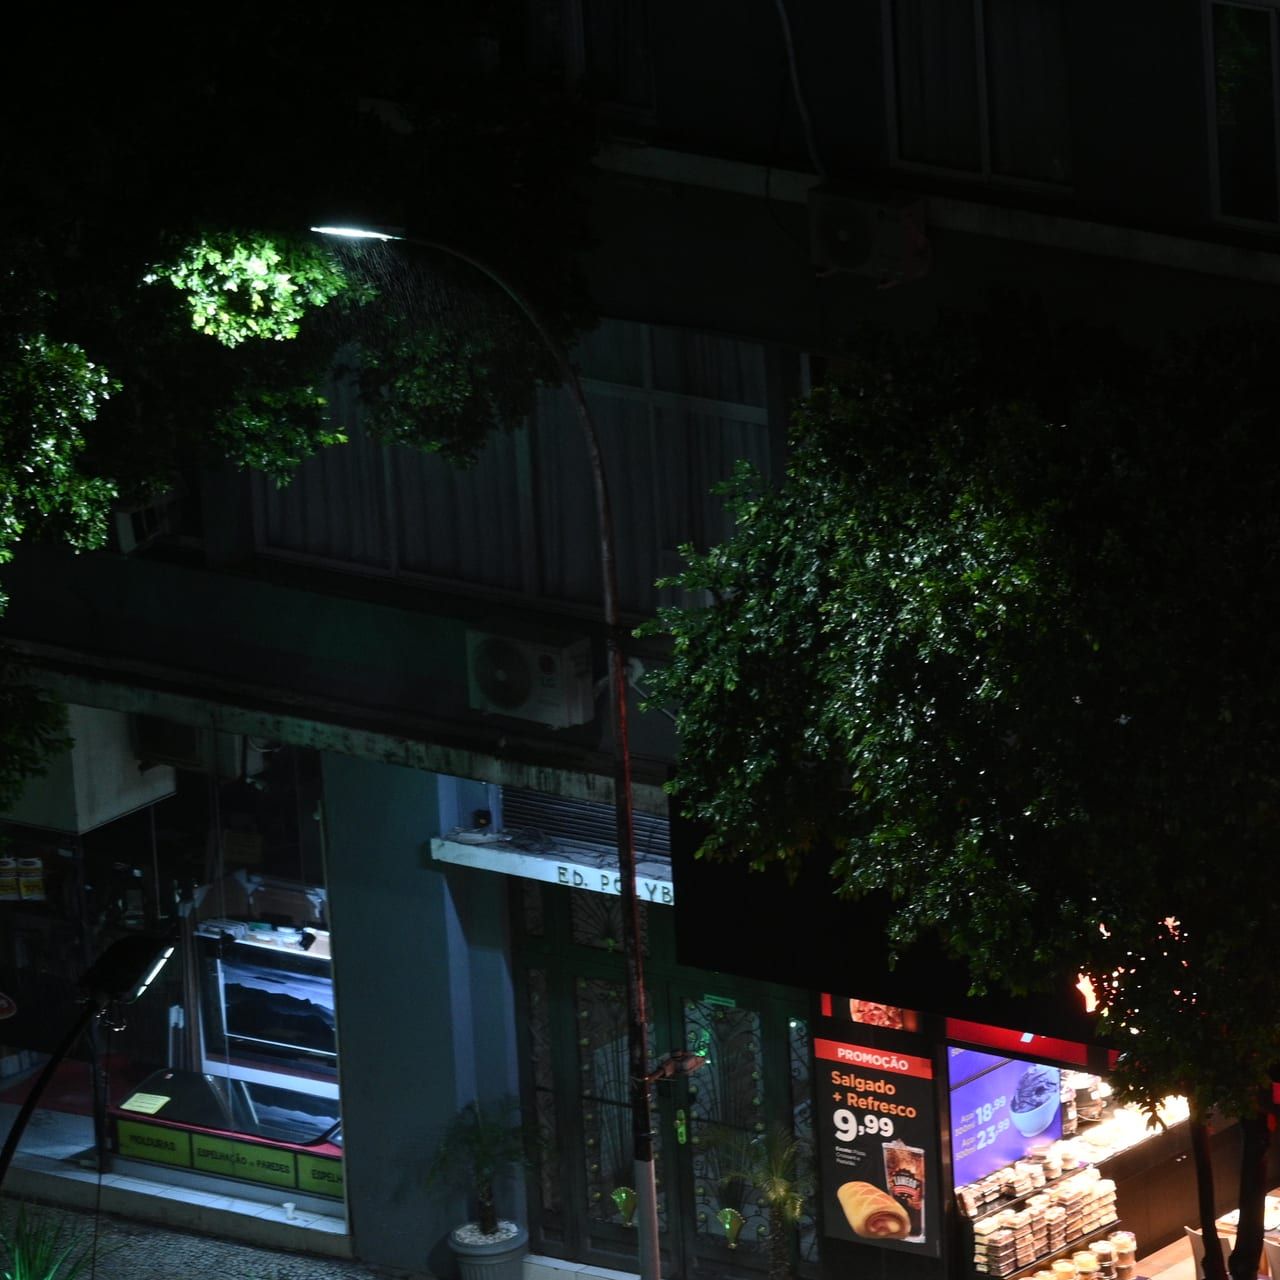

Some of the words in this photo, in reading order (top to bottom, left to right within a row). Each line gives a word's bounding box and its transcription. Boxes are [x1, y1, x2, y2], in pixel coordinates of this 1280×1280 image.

[557, 866, 588, 887] ED.
[600, 874, 673, 903] POYB
[837, 1047, 909, 1071] PROMOÇÃO
[831, 1070, 896, 1096] Salgado
[847, 1092, 917, 1118] Refresco
[833, 1108, 895, 1142] 9,99
